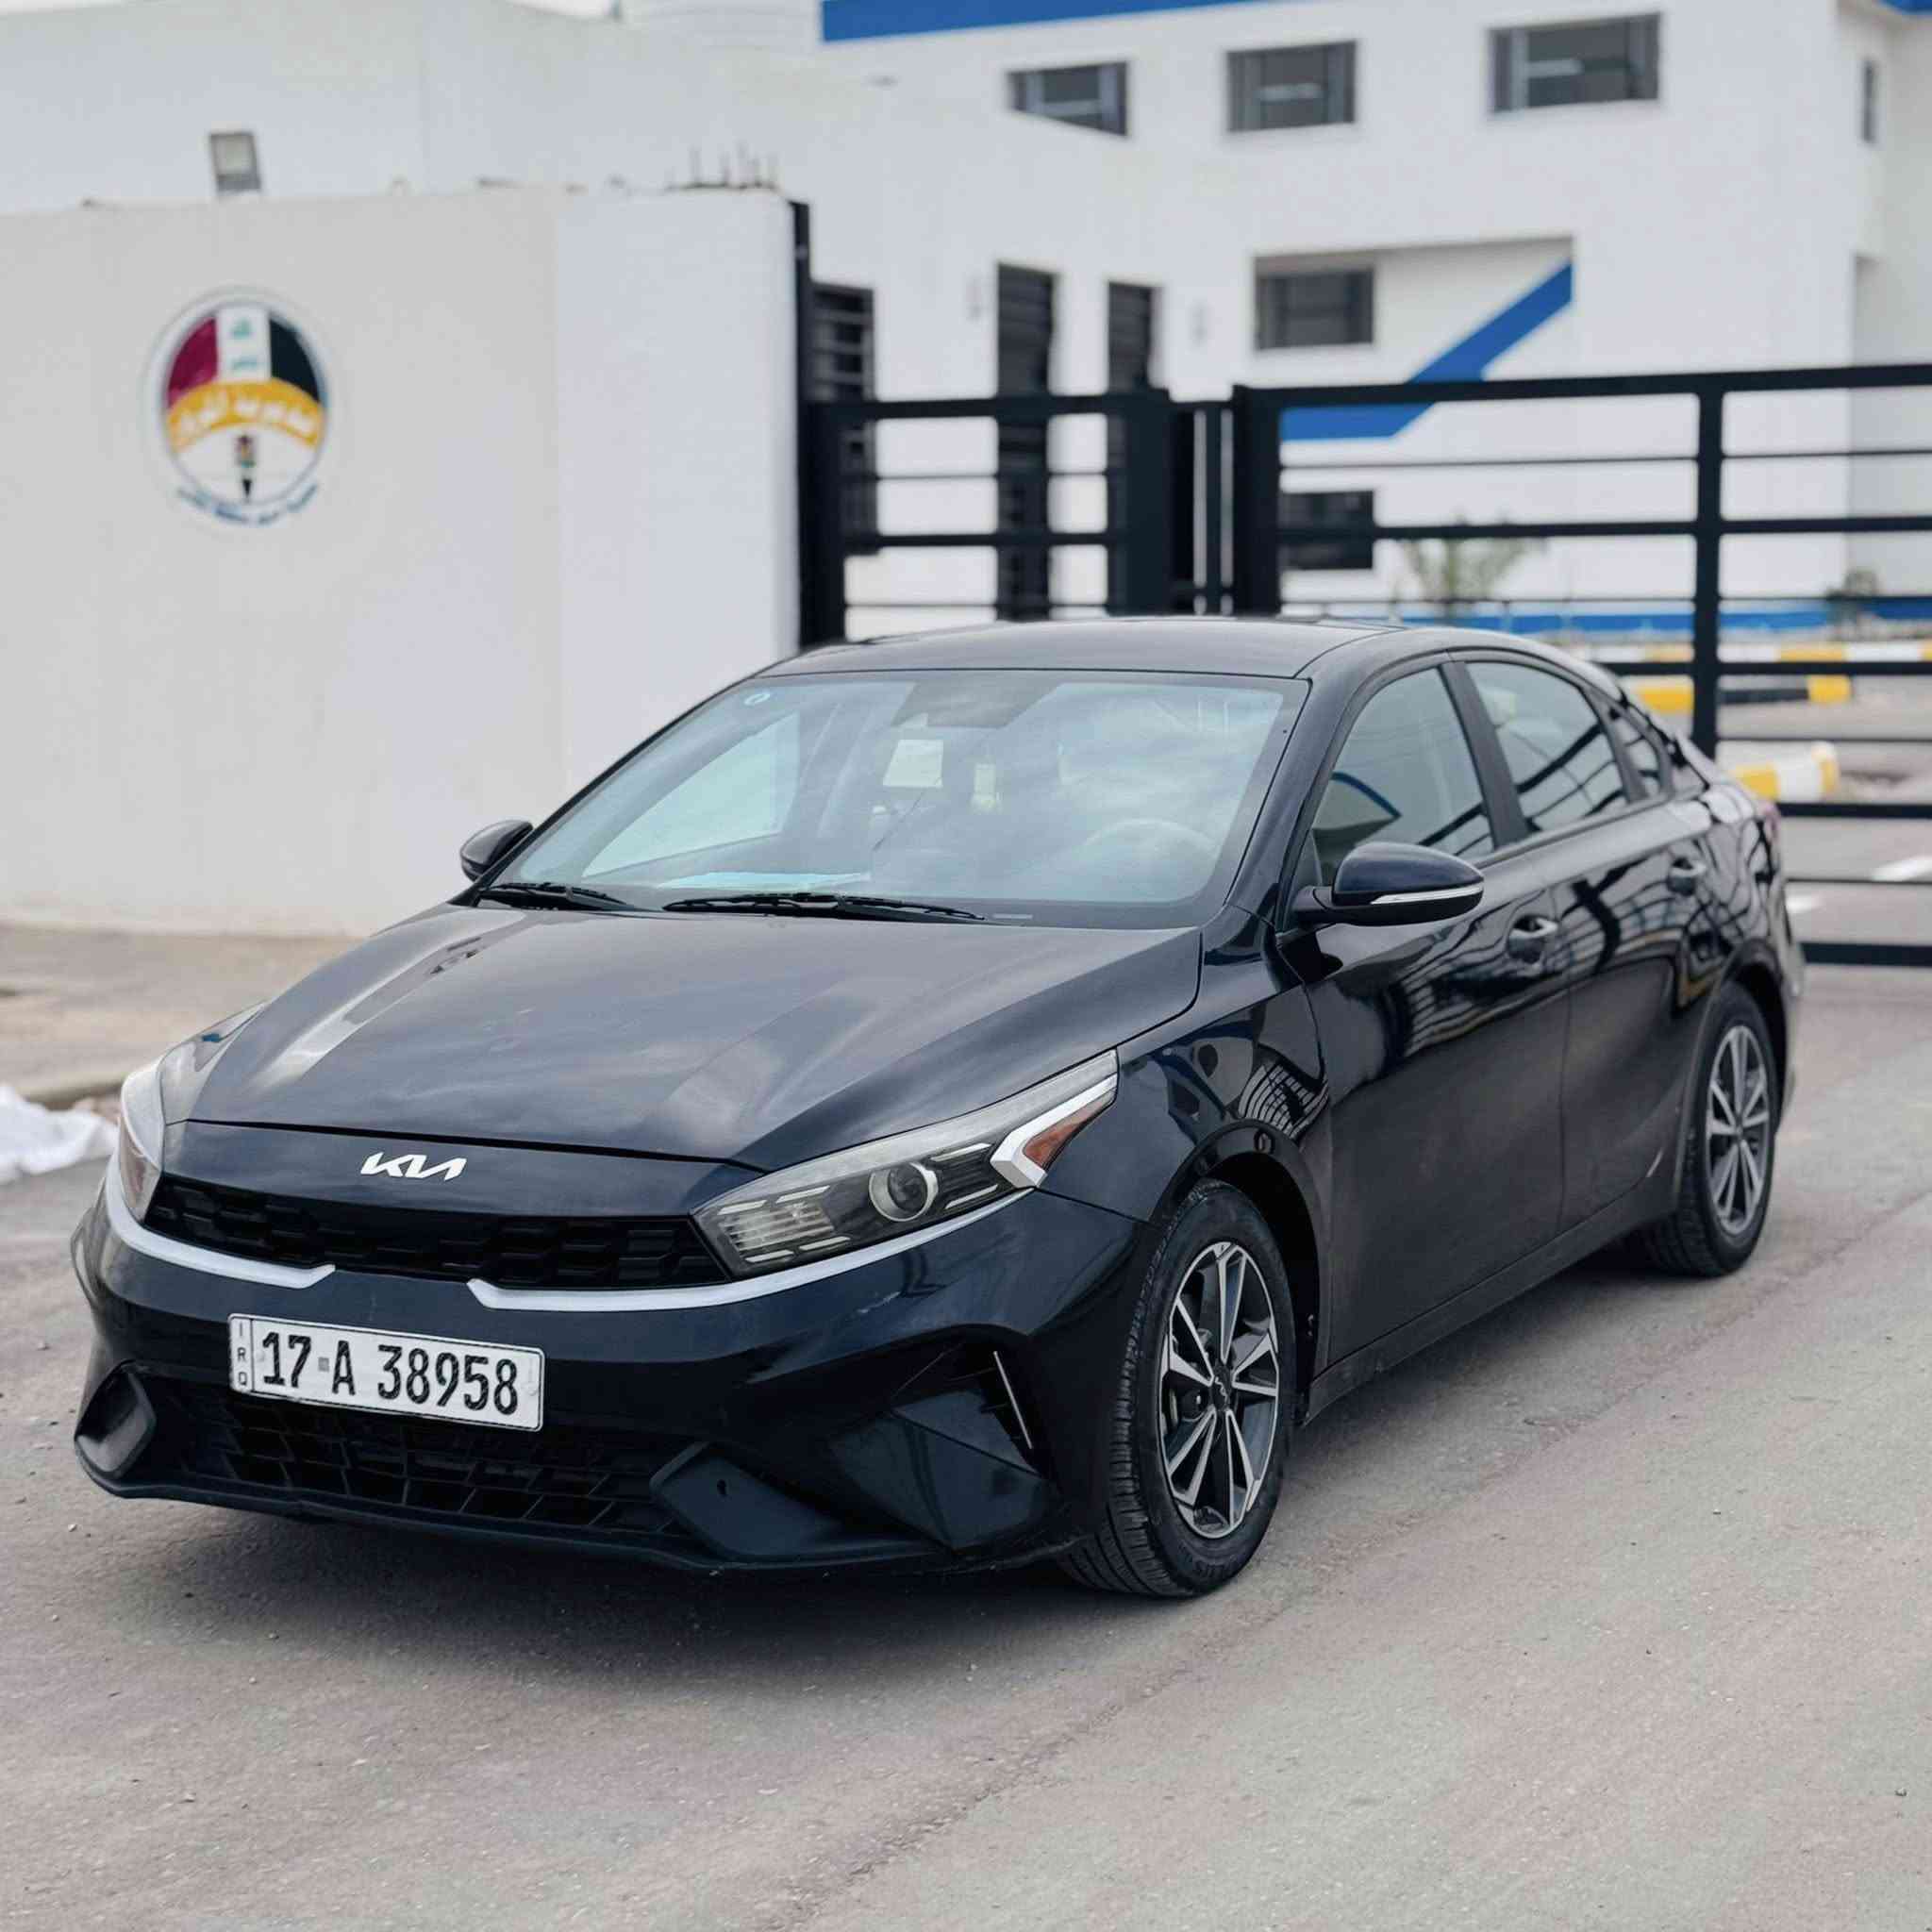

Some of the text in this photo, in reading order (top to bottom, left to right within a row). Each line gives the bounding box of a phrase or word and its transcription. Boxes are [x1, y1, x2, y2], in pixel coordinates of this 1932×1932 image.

[360, 1152, 467, 1181] KIA
[262, 1331, 518, 1416] 17 A 38958
